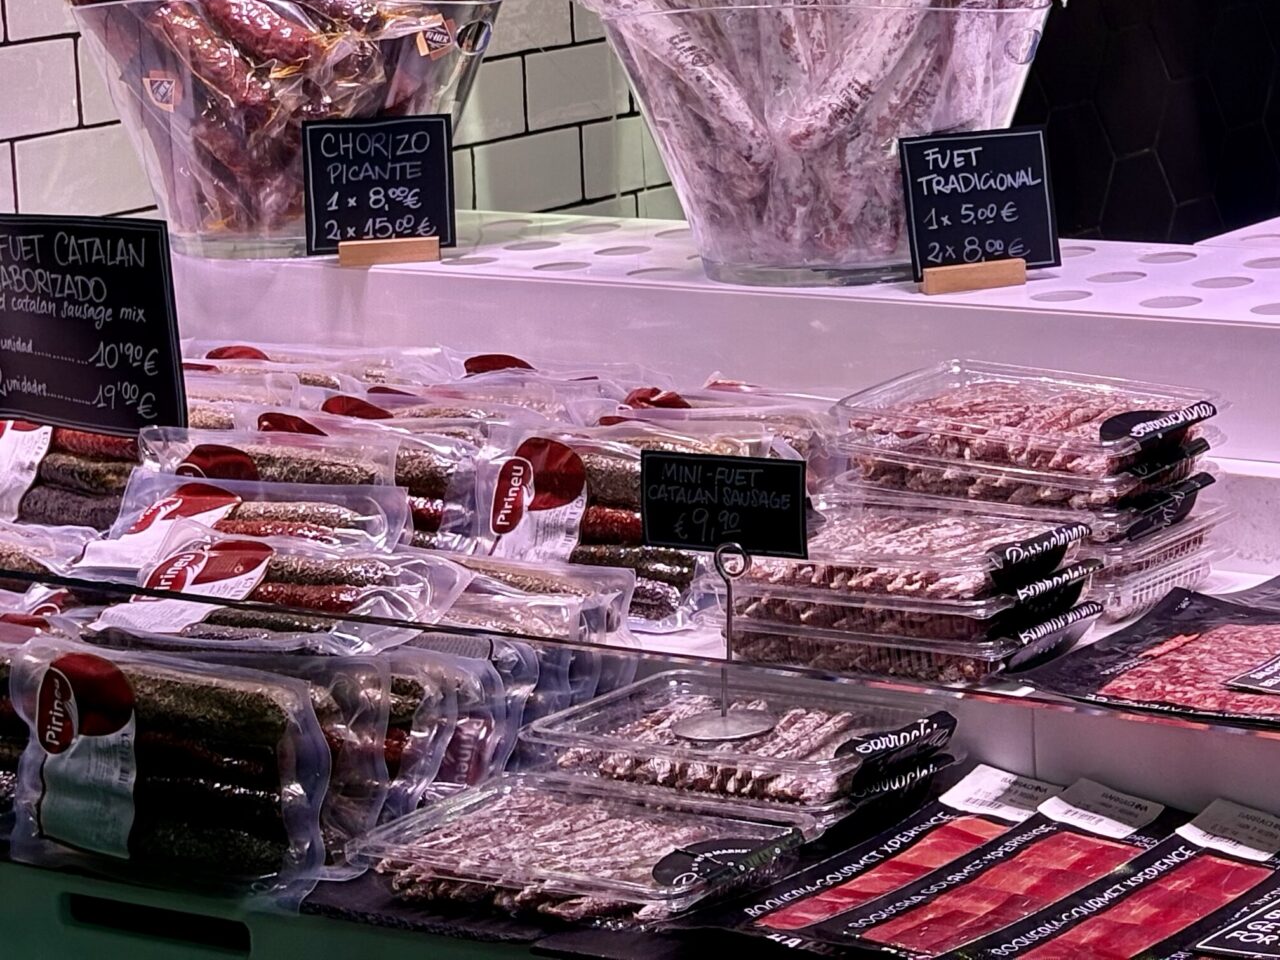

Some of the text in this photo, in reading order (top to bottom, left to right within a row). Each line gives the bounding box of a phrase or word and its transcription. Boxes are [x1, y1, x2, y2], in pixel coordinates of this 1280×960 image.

[321, 131, 430, 159] CHORIZO
[924, 147, 982, 170] FUET
[327, 161, 422, 184] PICANTE
[917, 167, 1041, 195] TRADICIONAL
[327, 192, 339, 211] 1
[325, 220, 341, 239] 2
[924, 208, 938, 229] 1
[54, 231, 145, 267] CATALAN
[928, 242, 943, 263] 2
[0, 265, 107, 303] ABORIZADO
[11, 296, 146, 329] catalan sausage mix
[496, 466, 524, 526] Pirineu
[648, 484, 791, 510] CATALAN SAUSAGE
[816, 851, 884, 889] GOURMET
[1056, 845, 1197, 924] GOURMET XPERIENCE
[1225, 930, 1279, 945] FOR
